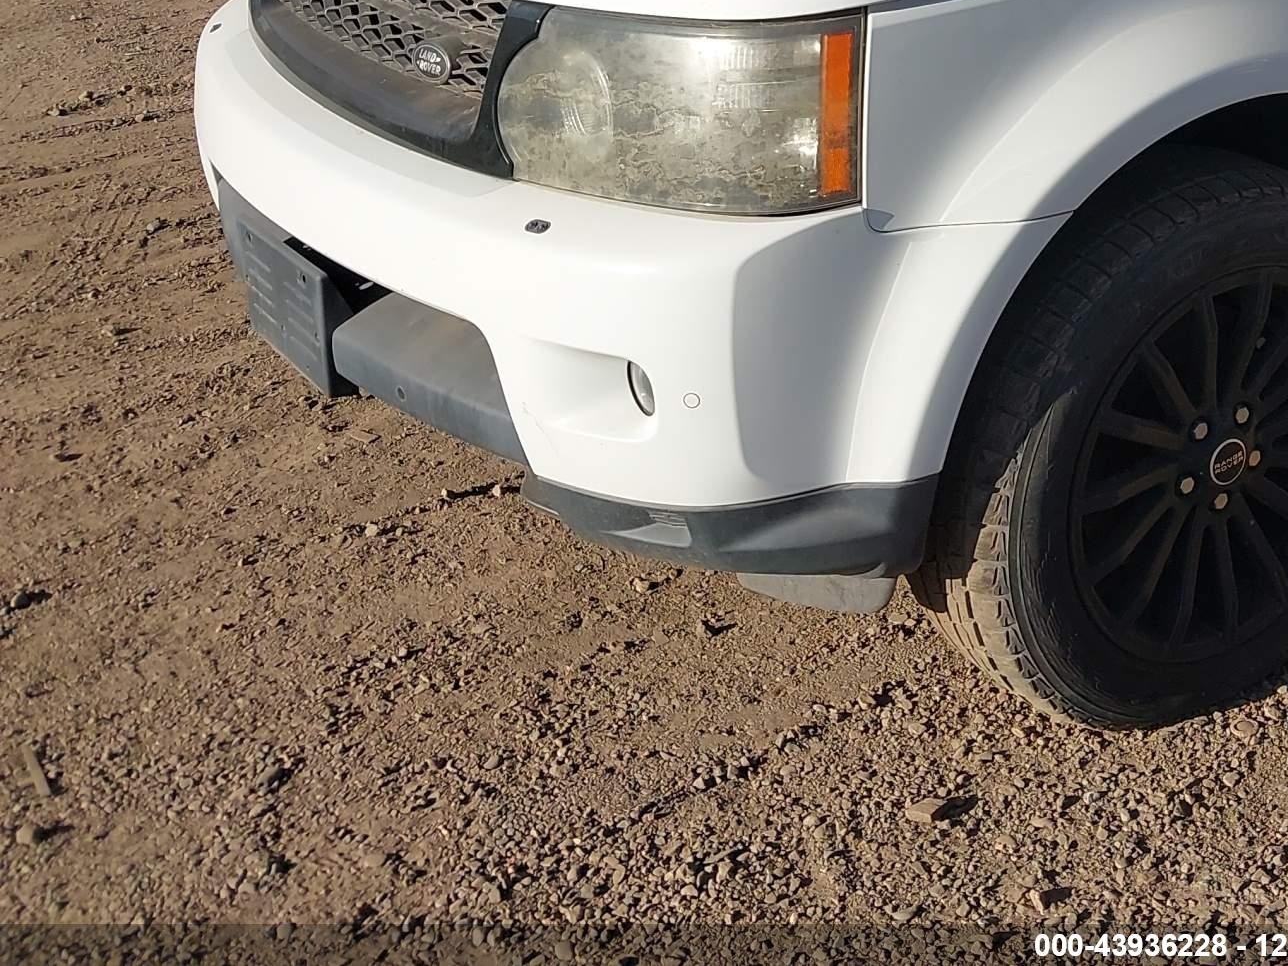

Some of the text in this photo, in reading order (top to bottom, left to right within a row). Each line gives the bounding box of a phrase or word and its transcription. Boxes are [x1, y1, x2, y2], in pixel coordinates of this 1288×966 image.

[419, 48, 437, 63] LAND
[419, 59, 442, 76] ROVER
[1214, 450, 1243, 470] RANGE
[1214, 456, 1244, 475] ROVER
